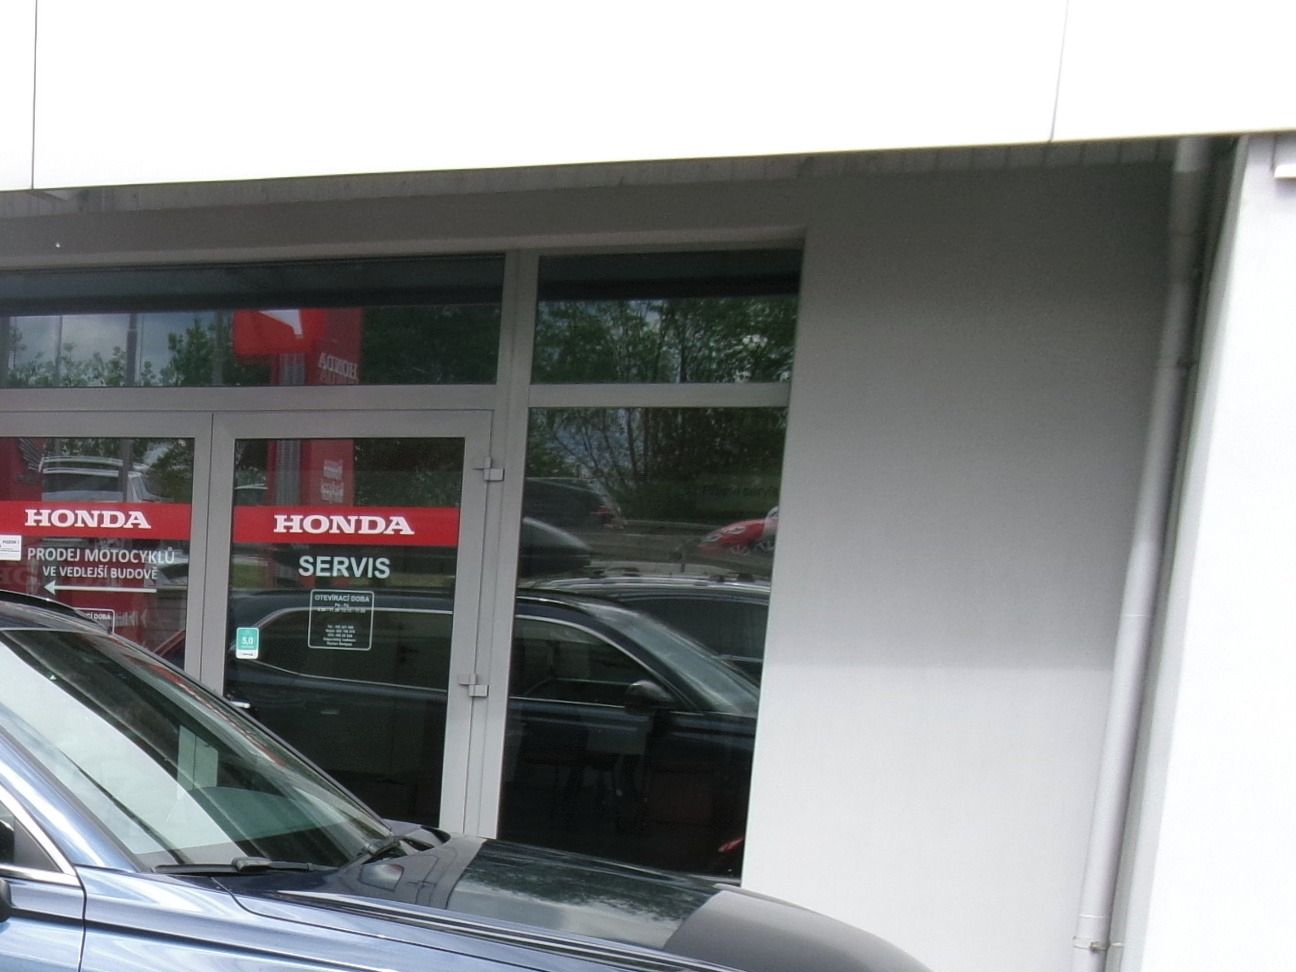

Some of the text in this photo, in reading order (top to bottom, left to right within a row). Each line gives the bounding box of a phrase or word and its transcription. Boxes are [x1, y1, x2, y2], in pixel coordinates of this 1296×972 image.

[24, 508, 152, 529] HONDA
[273, 514, 415, 535] HONDA
[27, 547, 80, 562] PRODEJ
[84, 546, 175, 564] MOTOCYKLŮ
[42, 566, 56, 577] VE
[59, 565, 108, 578] VEDLEJŠÍ
[110, 567, 158, 580] BUDOVĚ
[298, 555, 391, 579] SERVIS
